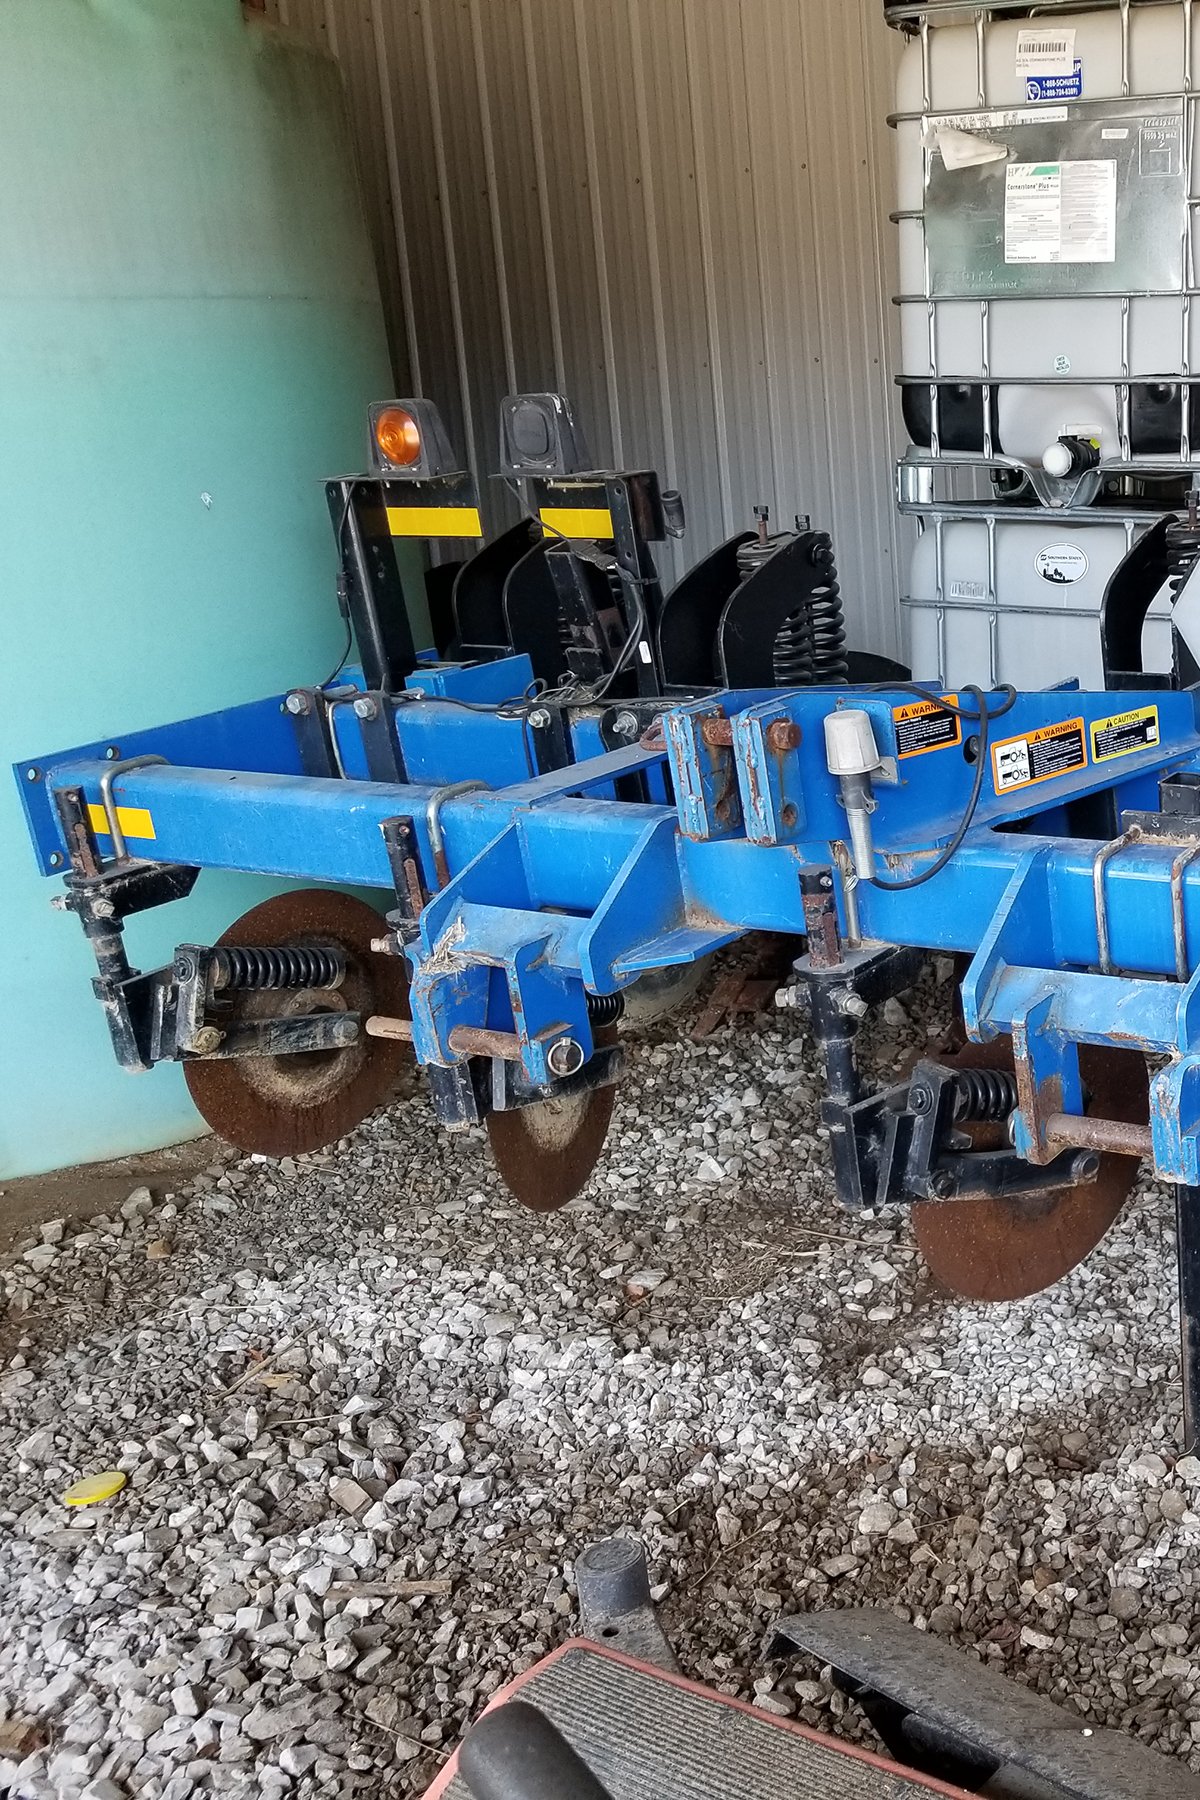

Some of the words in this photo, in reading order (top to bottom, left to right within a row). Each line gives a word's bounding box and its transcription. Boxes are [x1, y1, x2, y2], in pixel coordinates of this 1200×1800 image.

[911, 700, 950, 716] WARN
[1113, 712, 1140, 725] CAUTION
[1044, 722, 1078, 738] WARNING
